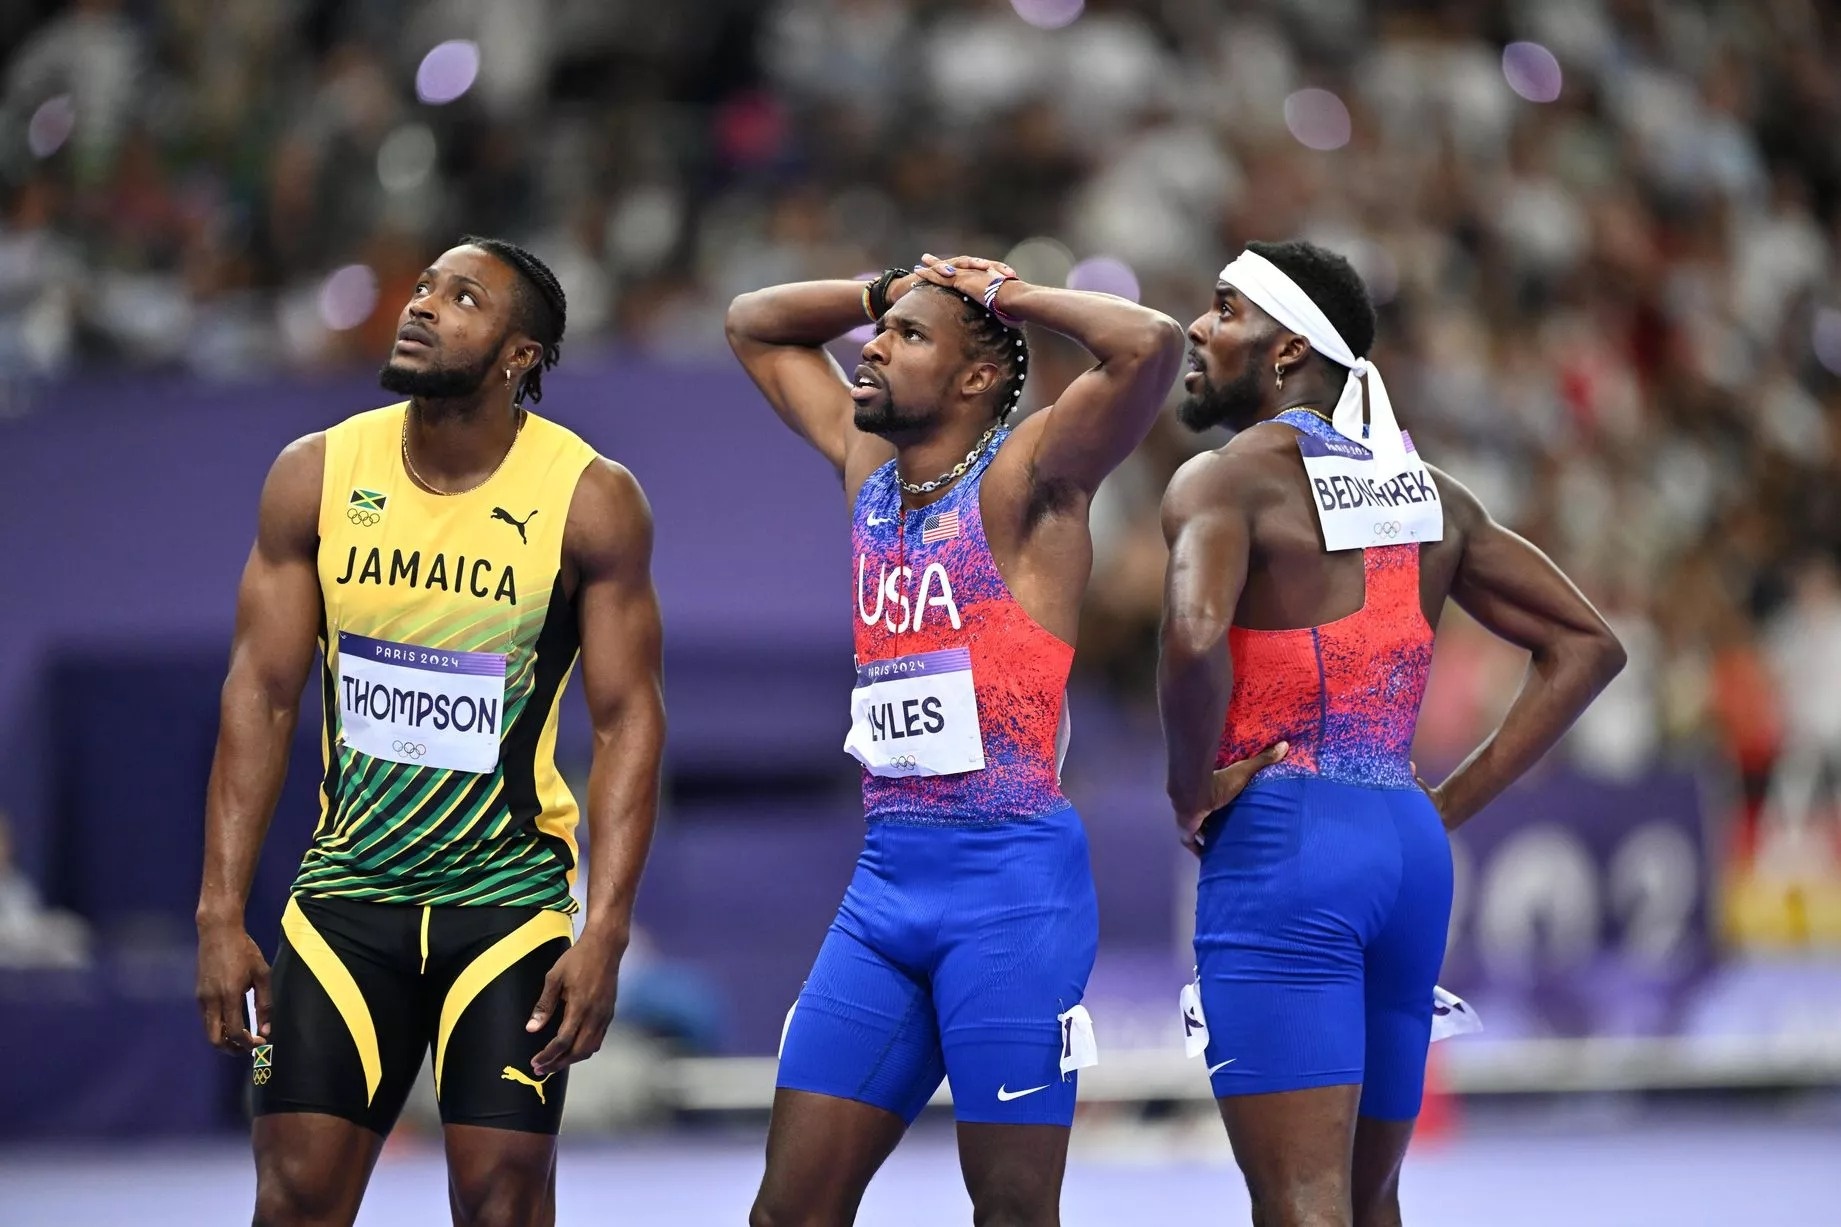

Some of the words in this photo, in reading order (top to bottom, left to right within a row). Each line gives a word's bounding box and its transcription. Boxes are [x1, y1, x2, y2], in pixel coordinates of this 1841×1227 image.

[336, 546, 516, 605] JAMAICA
[857, 553, 961, 633] USA
[376, 645, 416, 663] PARIS
[420, 653, 459, 668] 2024
[893, 660, 924, 674] 2024
[342, 675, 497, 734] THOMPSON
